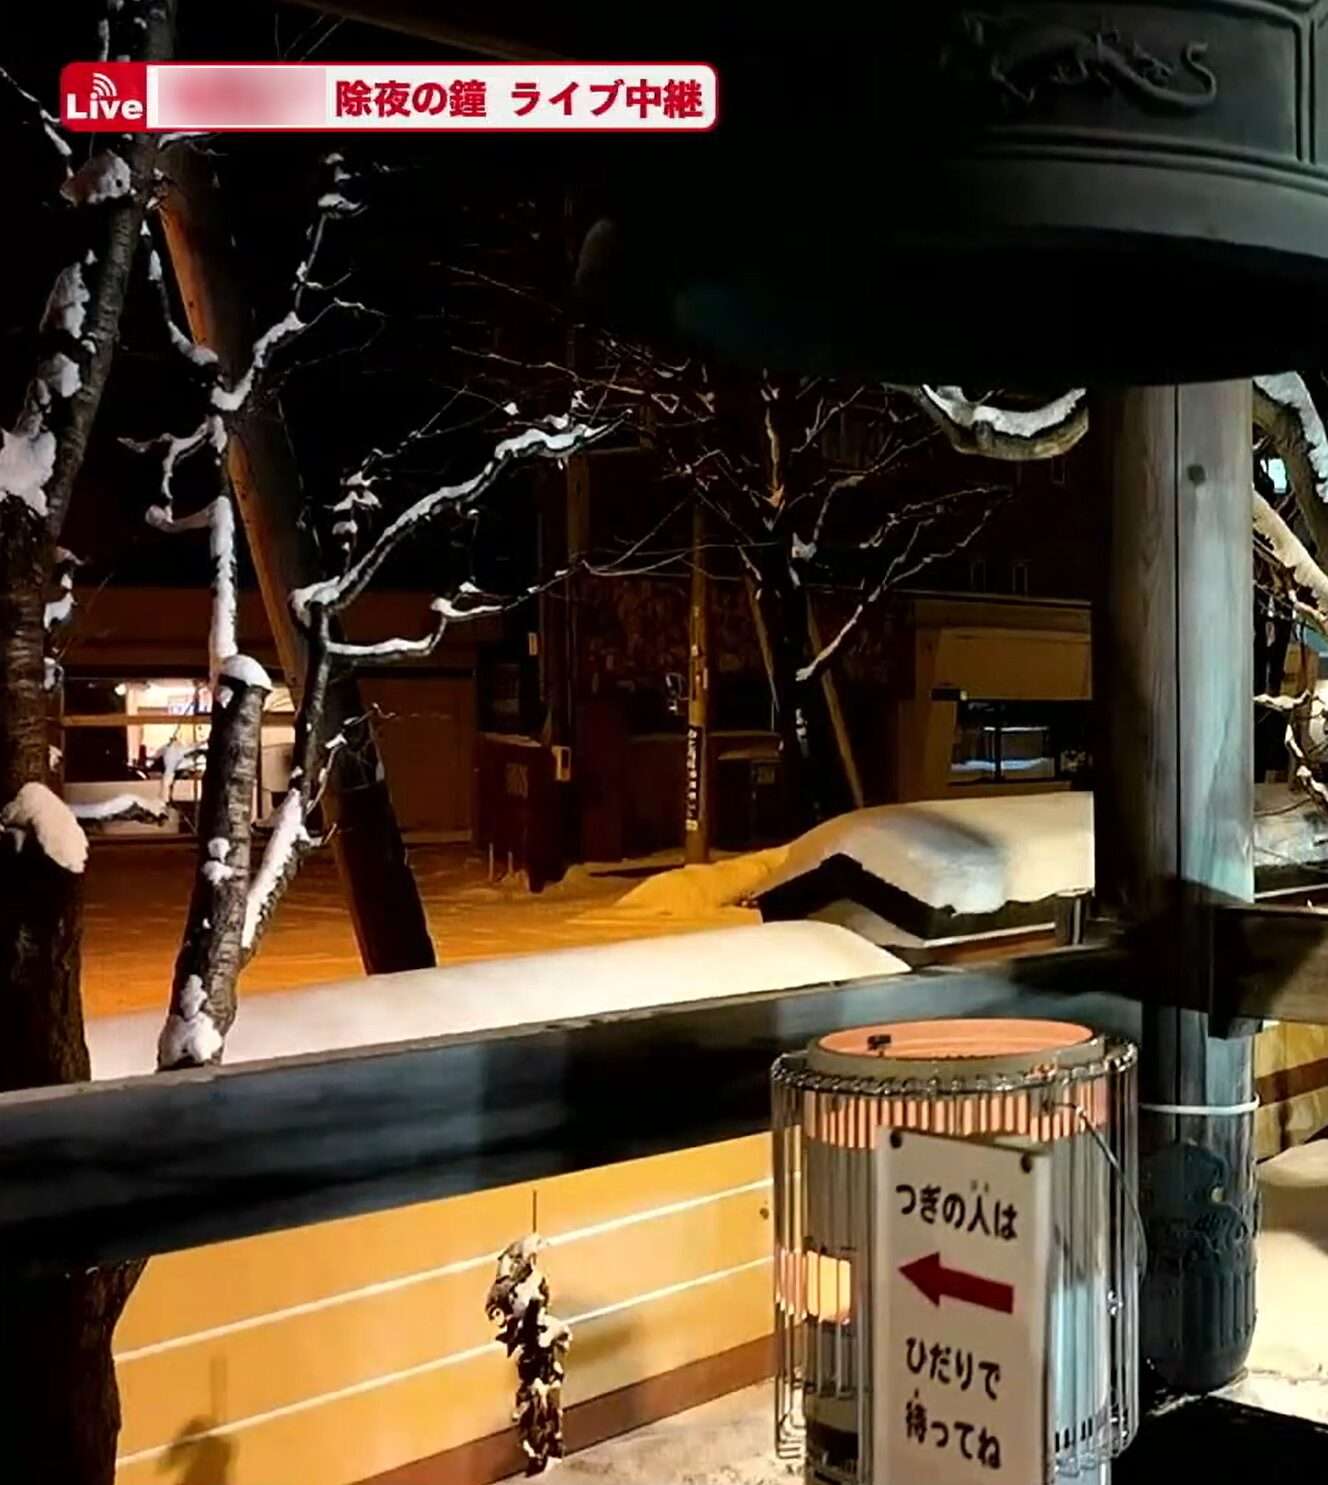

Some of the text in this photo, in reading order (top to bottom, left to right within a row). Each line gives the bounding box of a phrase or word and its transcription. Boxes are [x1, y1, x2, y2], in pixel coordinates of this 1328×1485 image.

[895, 1183, 1018, 1241] つぎの人は
[905, 1337, 1001, 1401] ひだりで
[905, 1399, 1002, 1470] 待ってね
